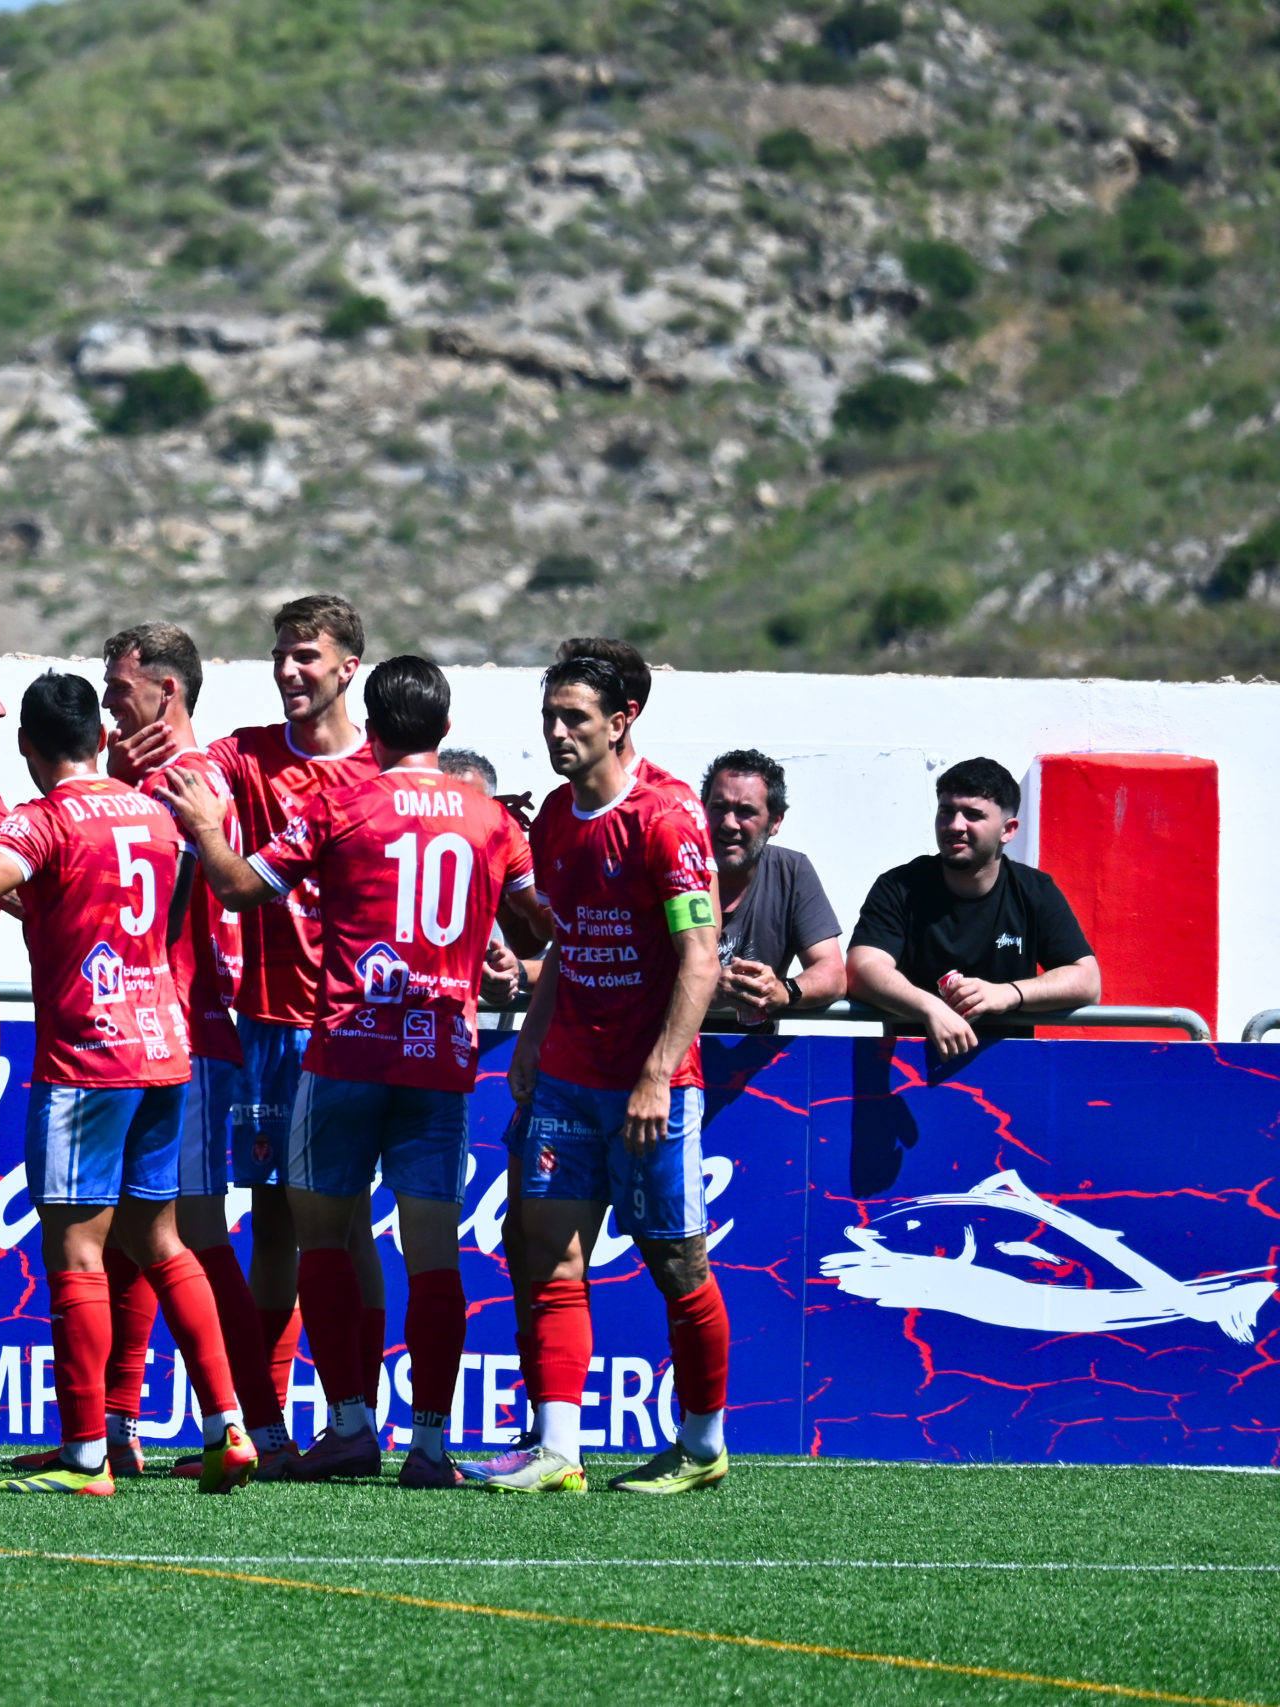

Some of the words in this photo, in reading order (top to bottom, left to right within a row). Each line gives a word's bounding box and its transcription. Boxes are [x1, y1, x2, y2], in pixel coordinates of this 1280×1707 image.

[61, 797, 92, 822] D.
[81, 792, 161, 817] PETCOFF
[394, 789, 464, 818] OMAR
[111, 825, 156, 936] 5
[384, 832, 473, 947] 10
[293, 902, 321, 919] BLA
[576, 905, 632, 921] Ricardo
[688, 897, 712, 925] C
[577, 921, 633, 937] Fuentes
[123, 965, 151, 978] blaya
[598, 971, 643, 988] GÓMEZ
[146, 1044, 170, 1061] ROS
[403, 1043, 436, 1059] ROS
[535, 1117, 572, 1133] TSH.
[633, 1188, 646, 1220] 9
